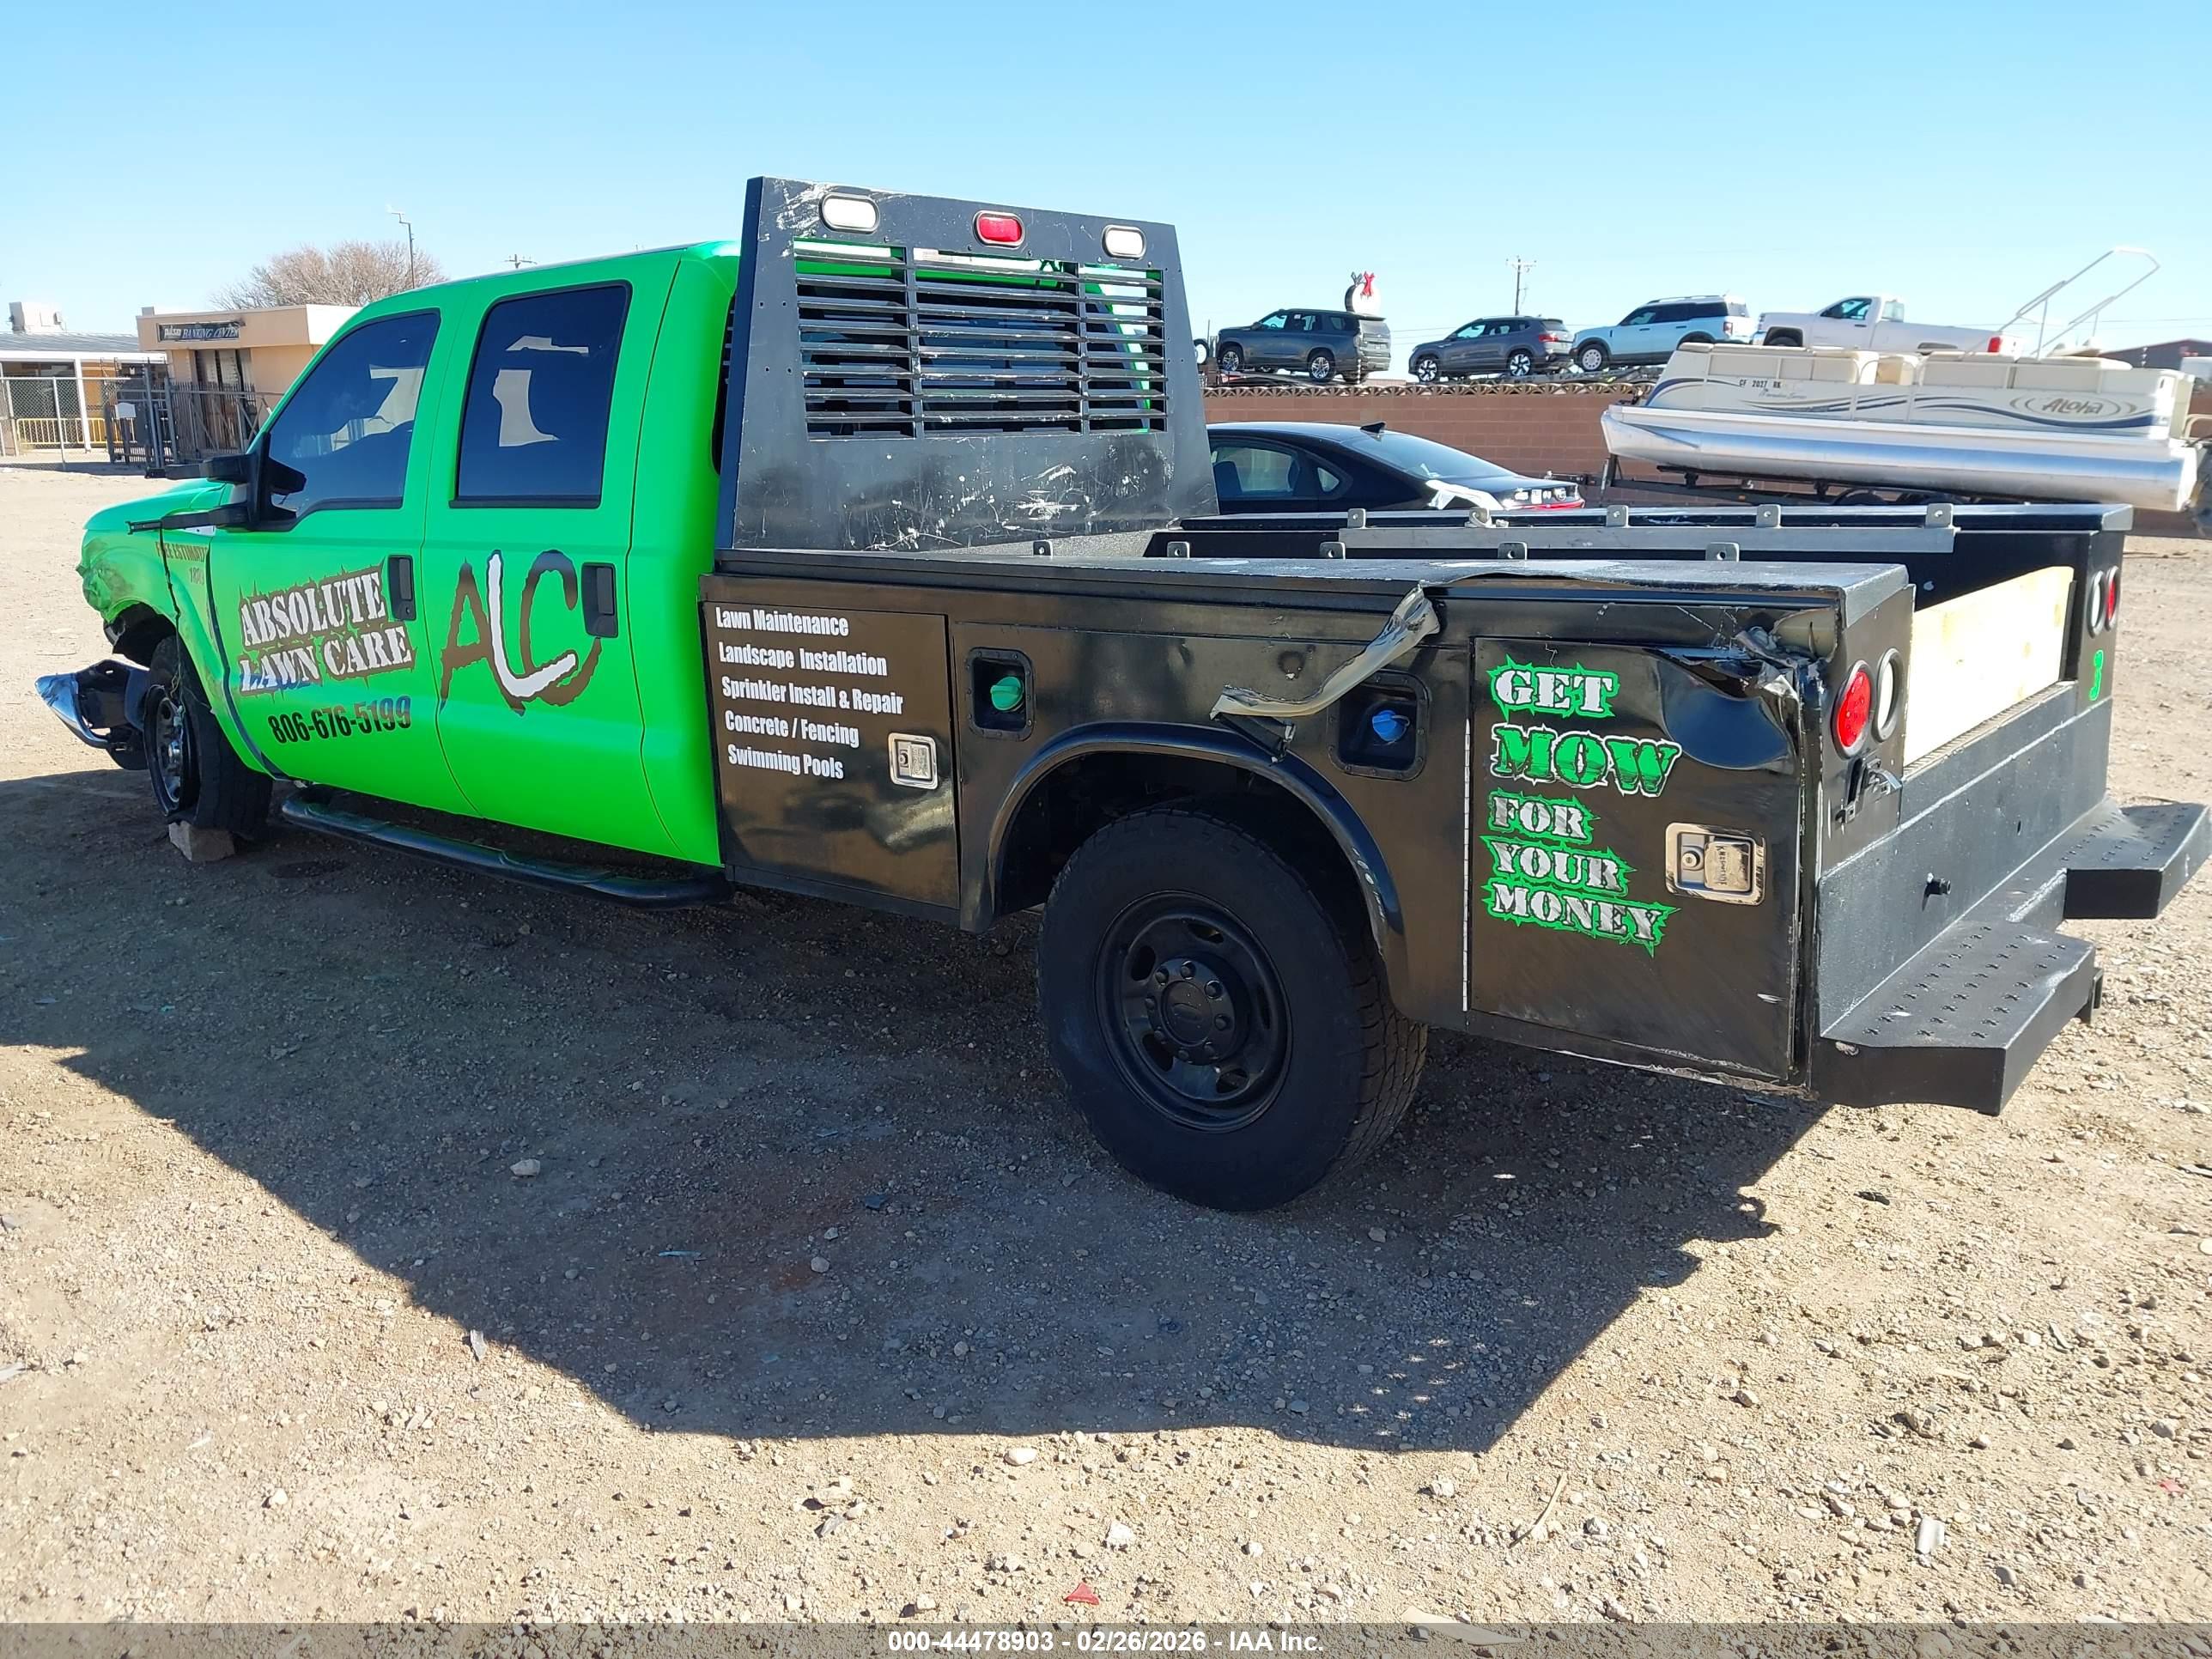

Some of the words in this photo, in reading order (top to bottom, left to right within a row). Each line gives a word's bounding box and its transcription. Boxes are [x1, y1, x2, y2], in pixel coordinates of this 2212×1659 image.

[182, 328, 213, 338] BANKING
[241, 572, 386, 647] ABSOLUTE
[715, 606, 751, 629] Lawn
[753, 609, 849, 636] Maintenance
[240, 646, 320, 692] LAWN
[324, 626, 411, 676] CARE
[718, 641, 795, 670] Landscape
[799, 648, 887, 676] Installation
[721, 676, 787, 702] Sprinkler
[788, 682, 836, 708] Install
[839, 690, 850, 709] &
[852, 688, 903, 715] Repair
[1496, 670, 1613, 713] GET
[267, 695, 411, 744] 806-676-5199
[725, 710, 789, 738] Concrete
[792, 717, 798, 738] /
[800, 719, 860, 749] Fencing
[727, 744, 800, 775] Swimming
[803, 753, 844, 779] Pools
[1492, 725, 1680, 796] MOW
[1491, 795, 1587, 840] FOR
[1492, 841, 1623, 892] YOUR
[1492, 881, 1662, 941] MONEY
